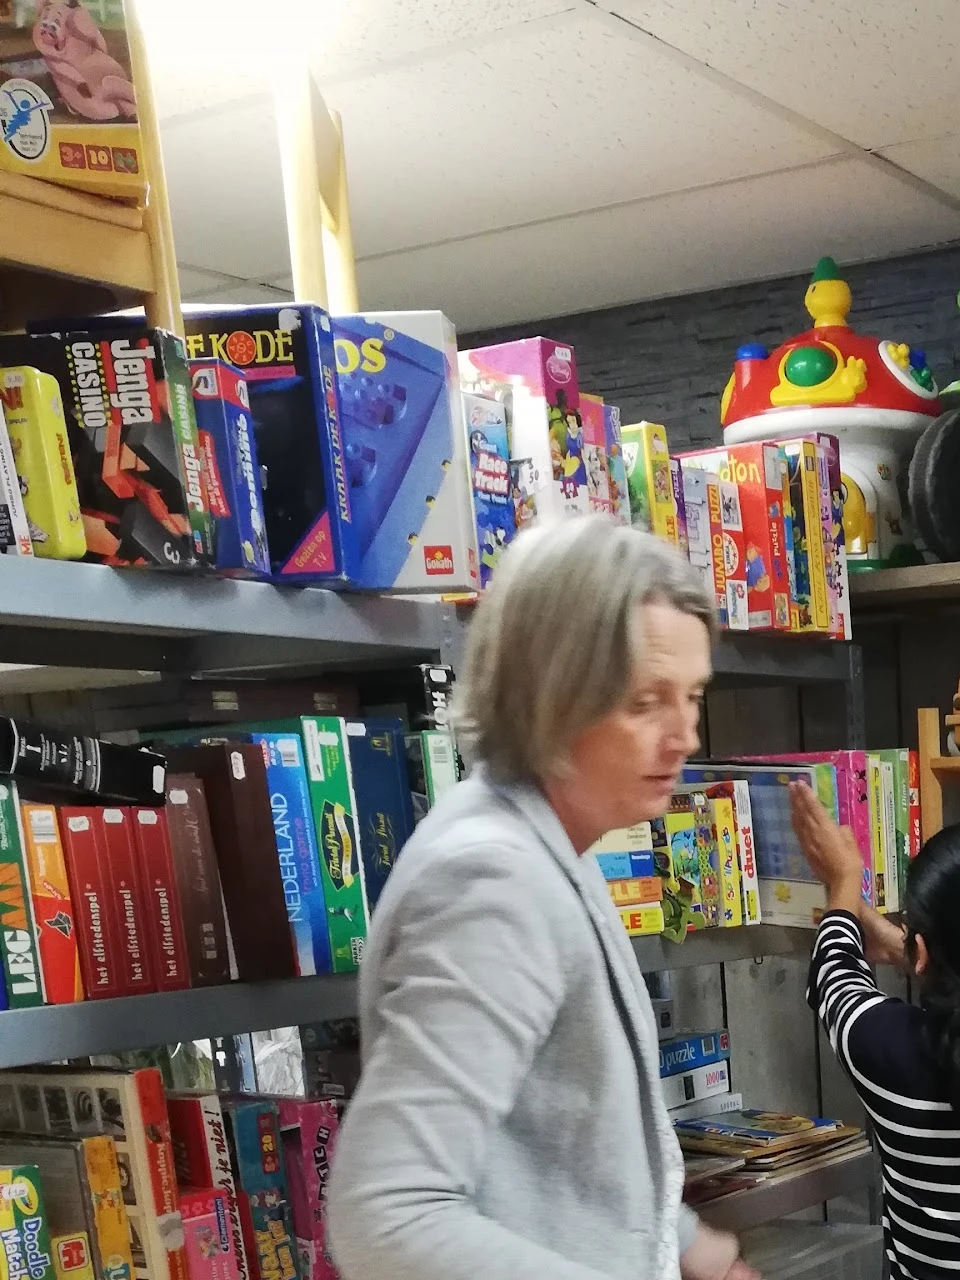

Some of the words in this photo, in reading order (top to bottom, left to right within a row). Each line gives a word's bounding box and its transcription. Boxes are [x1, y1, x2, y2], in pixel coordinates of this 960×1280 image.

[71, 341, 107, 427] CASINO
[111, 339, 155, 425] Jenga
[182, 442, 204, 512] Jenga
[426, 554, 453, 572] Goliath
[711, 533, 726, 593] JUMBO
[270, 792, 303, 922] NEDERLAND
[741, 826, 755, 879] duet
[84, 891, 108, 963] elfstedenspel
[119, 888, 140, 959] elfstedenspel
[154, 887, 175, 956] elfstedenspel
[97, 966, 109, 985] het
[132, 962, 143, 981] het
[167, 959, 178, 977] het
[23, 1216, 50, 1280] Doodle
